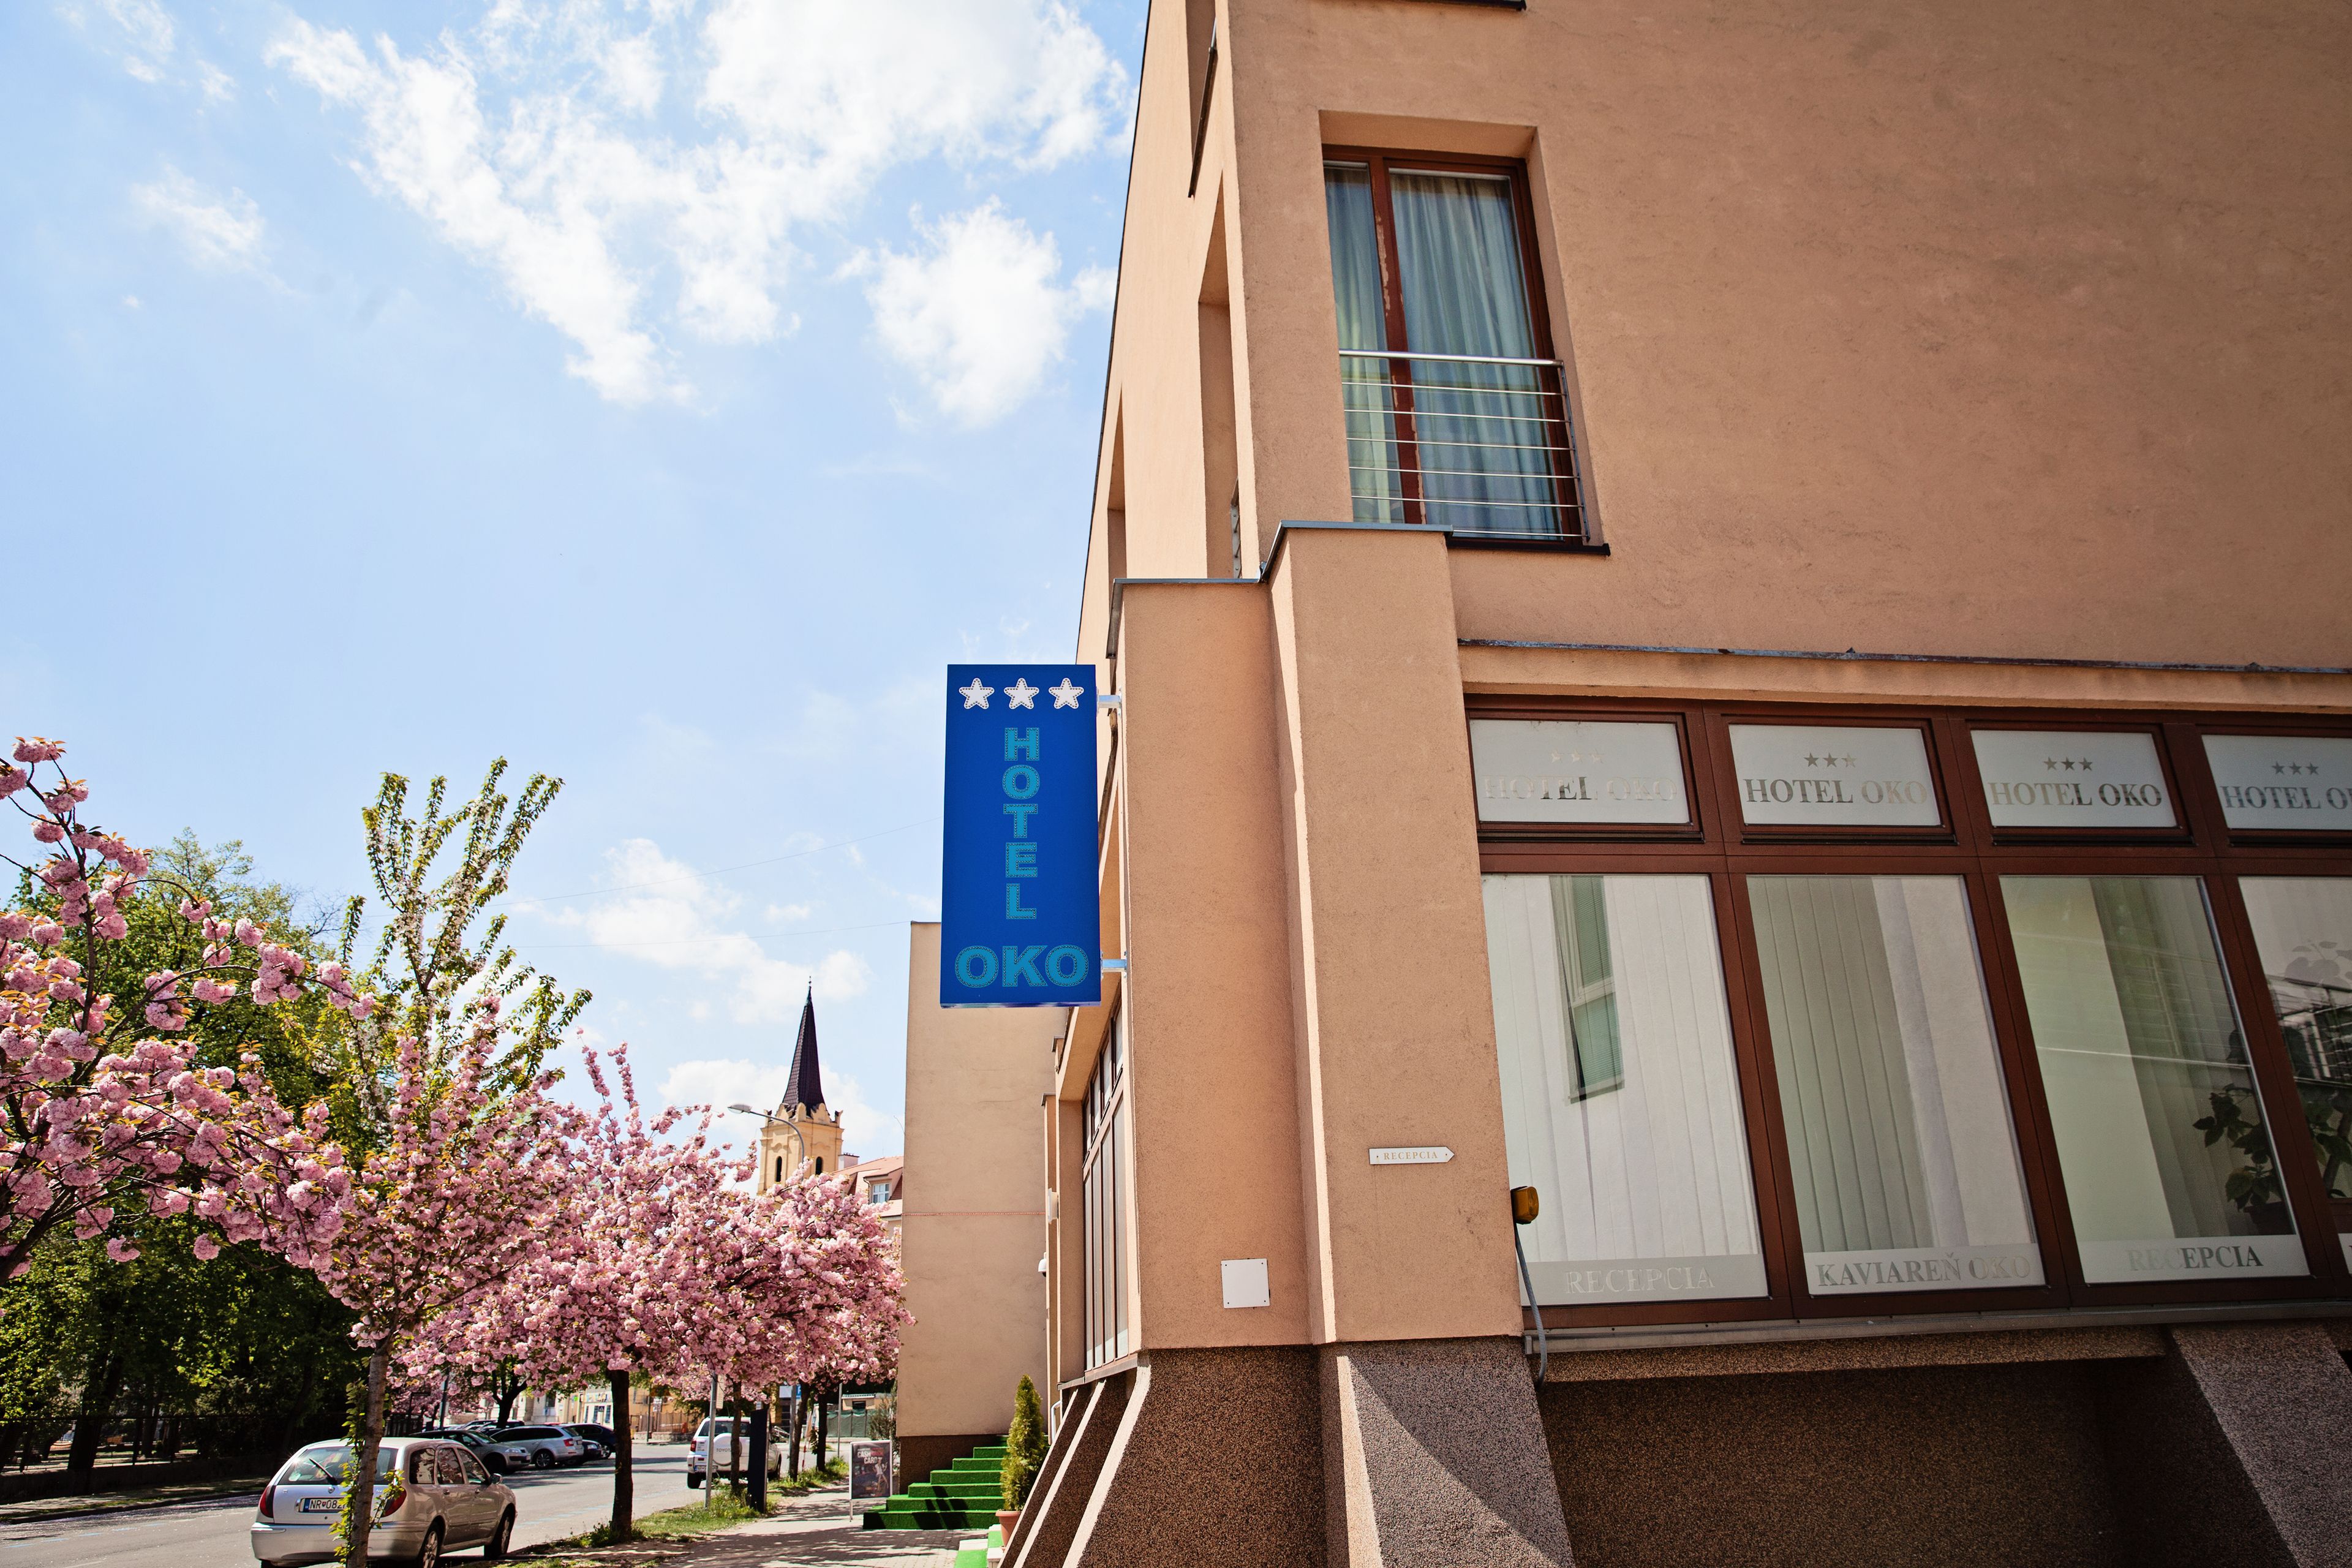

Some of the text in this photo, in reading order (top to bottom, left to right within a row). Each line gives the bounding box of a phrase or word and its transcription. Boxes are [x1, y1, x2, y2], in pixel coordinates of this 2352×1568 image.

[1483, 774, 1678, 801] HOTEL OKO
[1743, 778, 1928, 804] HOTEL OKO
[1987, 782, 2162, 807] HOTEL OKO
[2219, 785, 2352, 810] HOTEL O
[1002, 727, 1040, 919] HOTEL
[955, 944, 1090, 989] OKO
[1383, 1151, 1438, 1161] RECEPCIA
[1814, 1251, 2031, 1287] KAVIAREŇ OKO
[2125, 1245, 2264, 1272] RECEPCIA
[1566, 1266, 1716, 1294] RECEPCIA
[309, 1500, 322, 1509] NR
